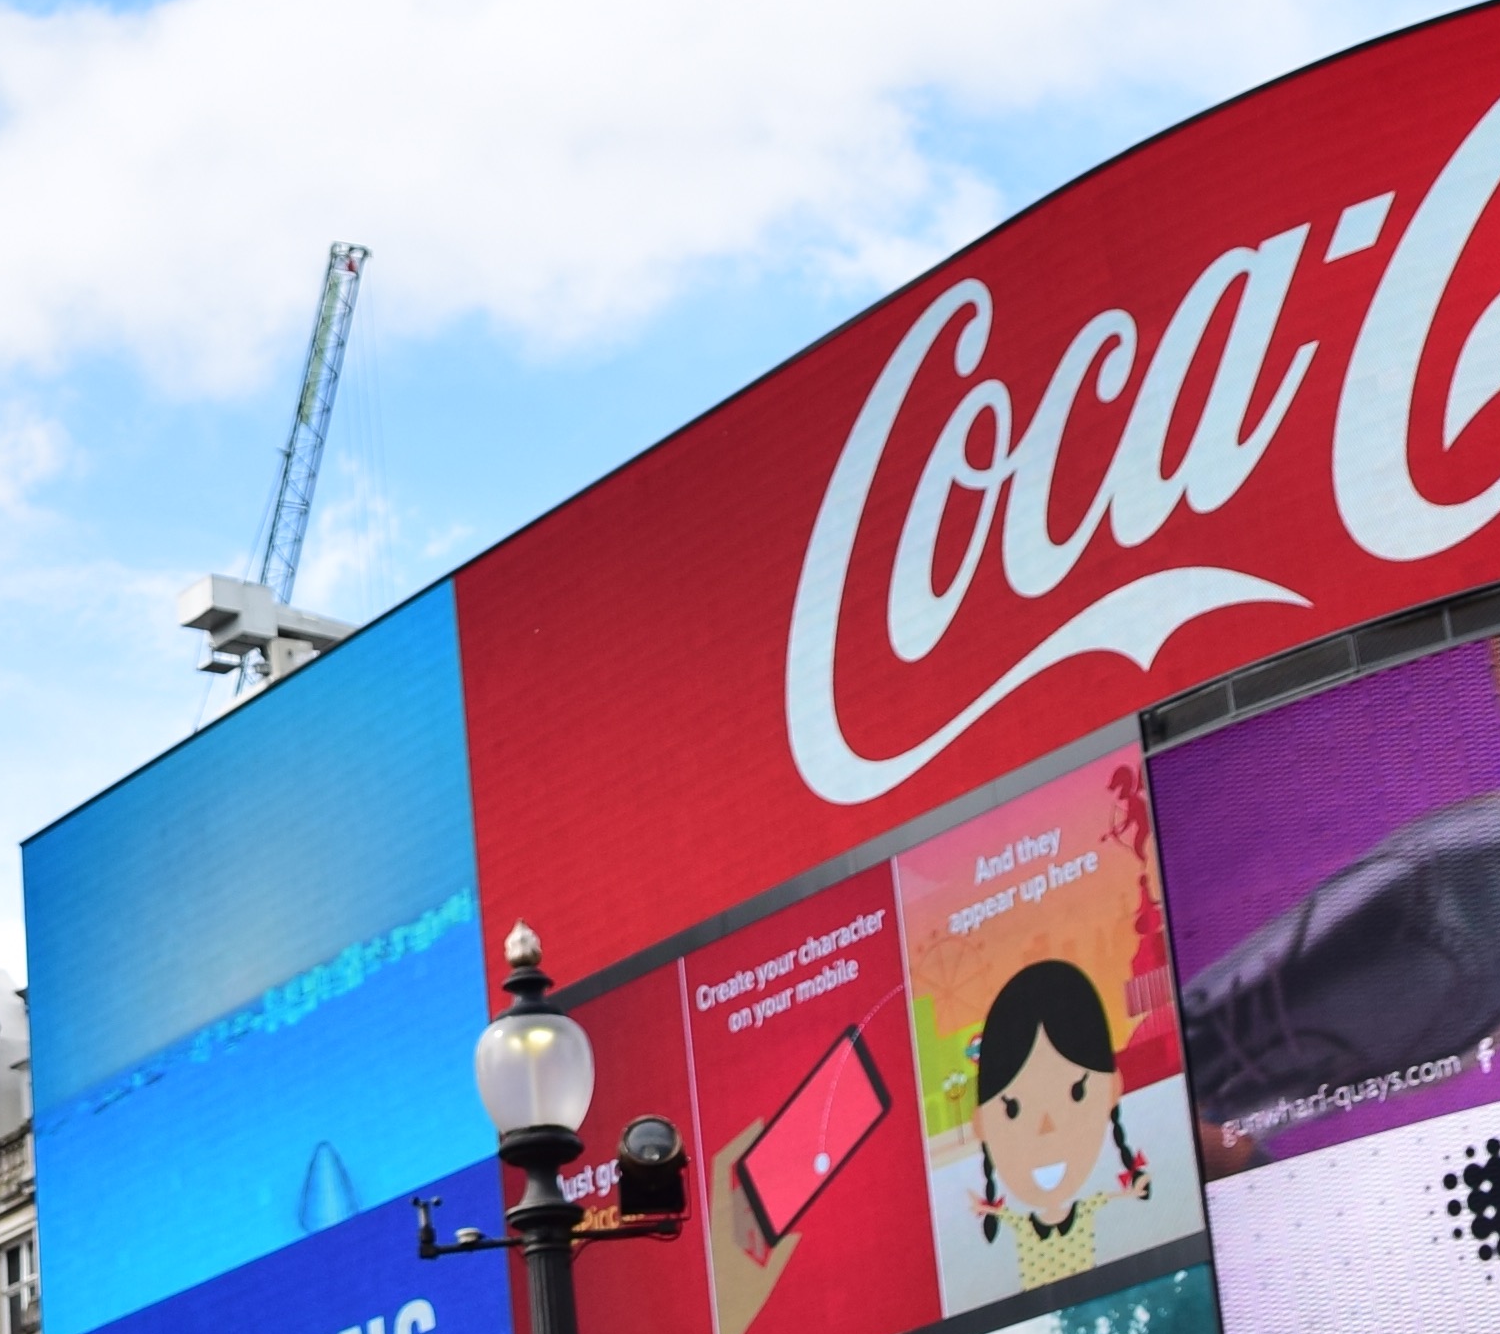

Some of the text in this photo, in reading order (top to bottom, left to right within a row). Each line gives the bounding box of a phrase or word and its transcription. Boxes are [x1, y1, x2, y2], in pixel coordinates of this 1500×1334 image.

[948, 851, 1099, 934] appear up here
[974, 827, 1061, 885] And they
[696, 909, 886, 1011] Create your character
[728, 958, 859, 1033] on your mobile
[1221, 1054, 1462, 1149] gunwharf-quays.com
